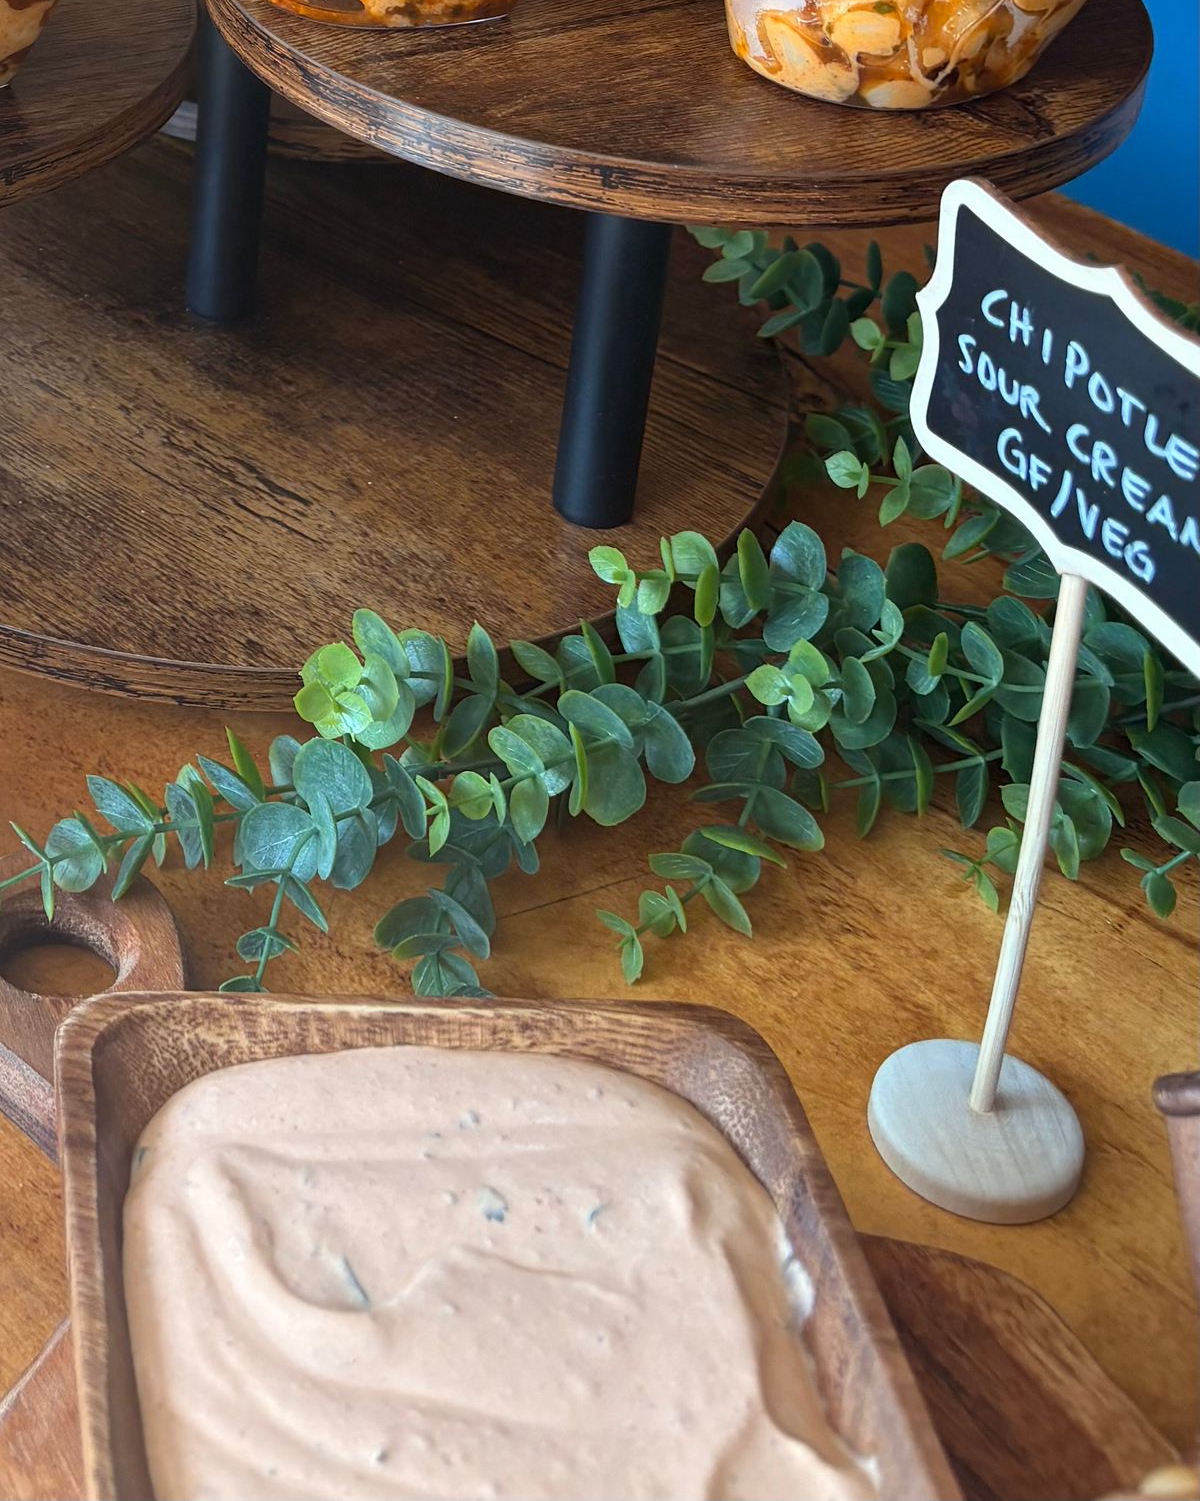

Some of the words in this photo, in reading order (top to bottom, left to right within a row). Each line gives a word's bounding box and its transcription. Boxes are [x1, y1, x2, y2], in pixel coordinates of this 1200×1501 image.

[957, 334, 1053, 435] SOUR
[981, 289, 1200, 482] CHIPOTLE
[997, 427, 1157, 585] GF/VEG
